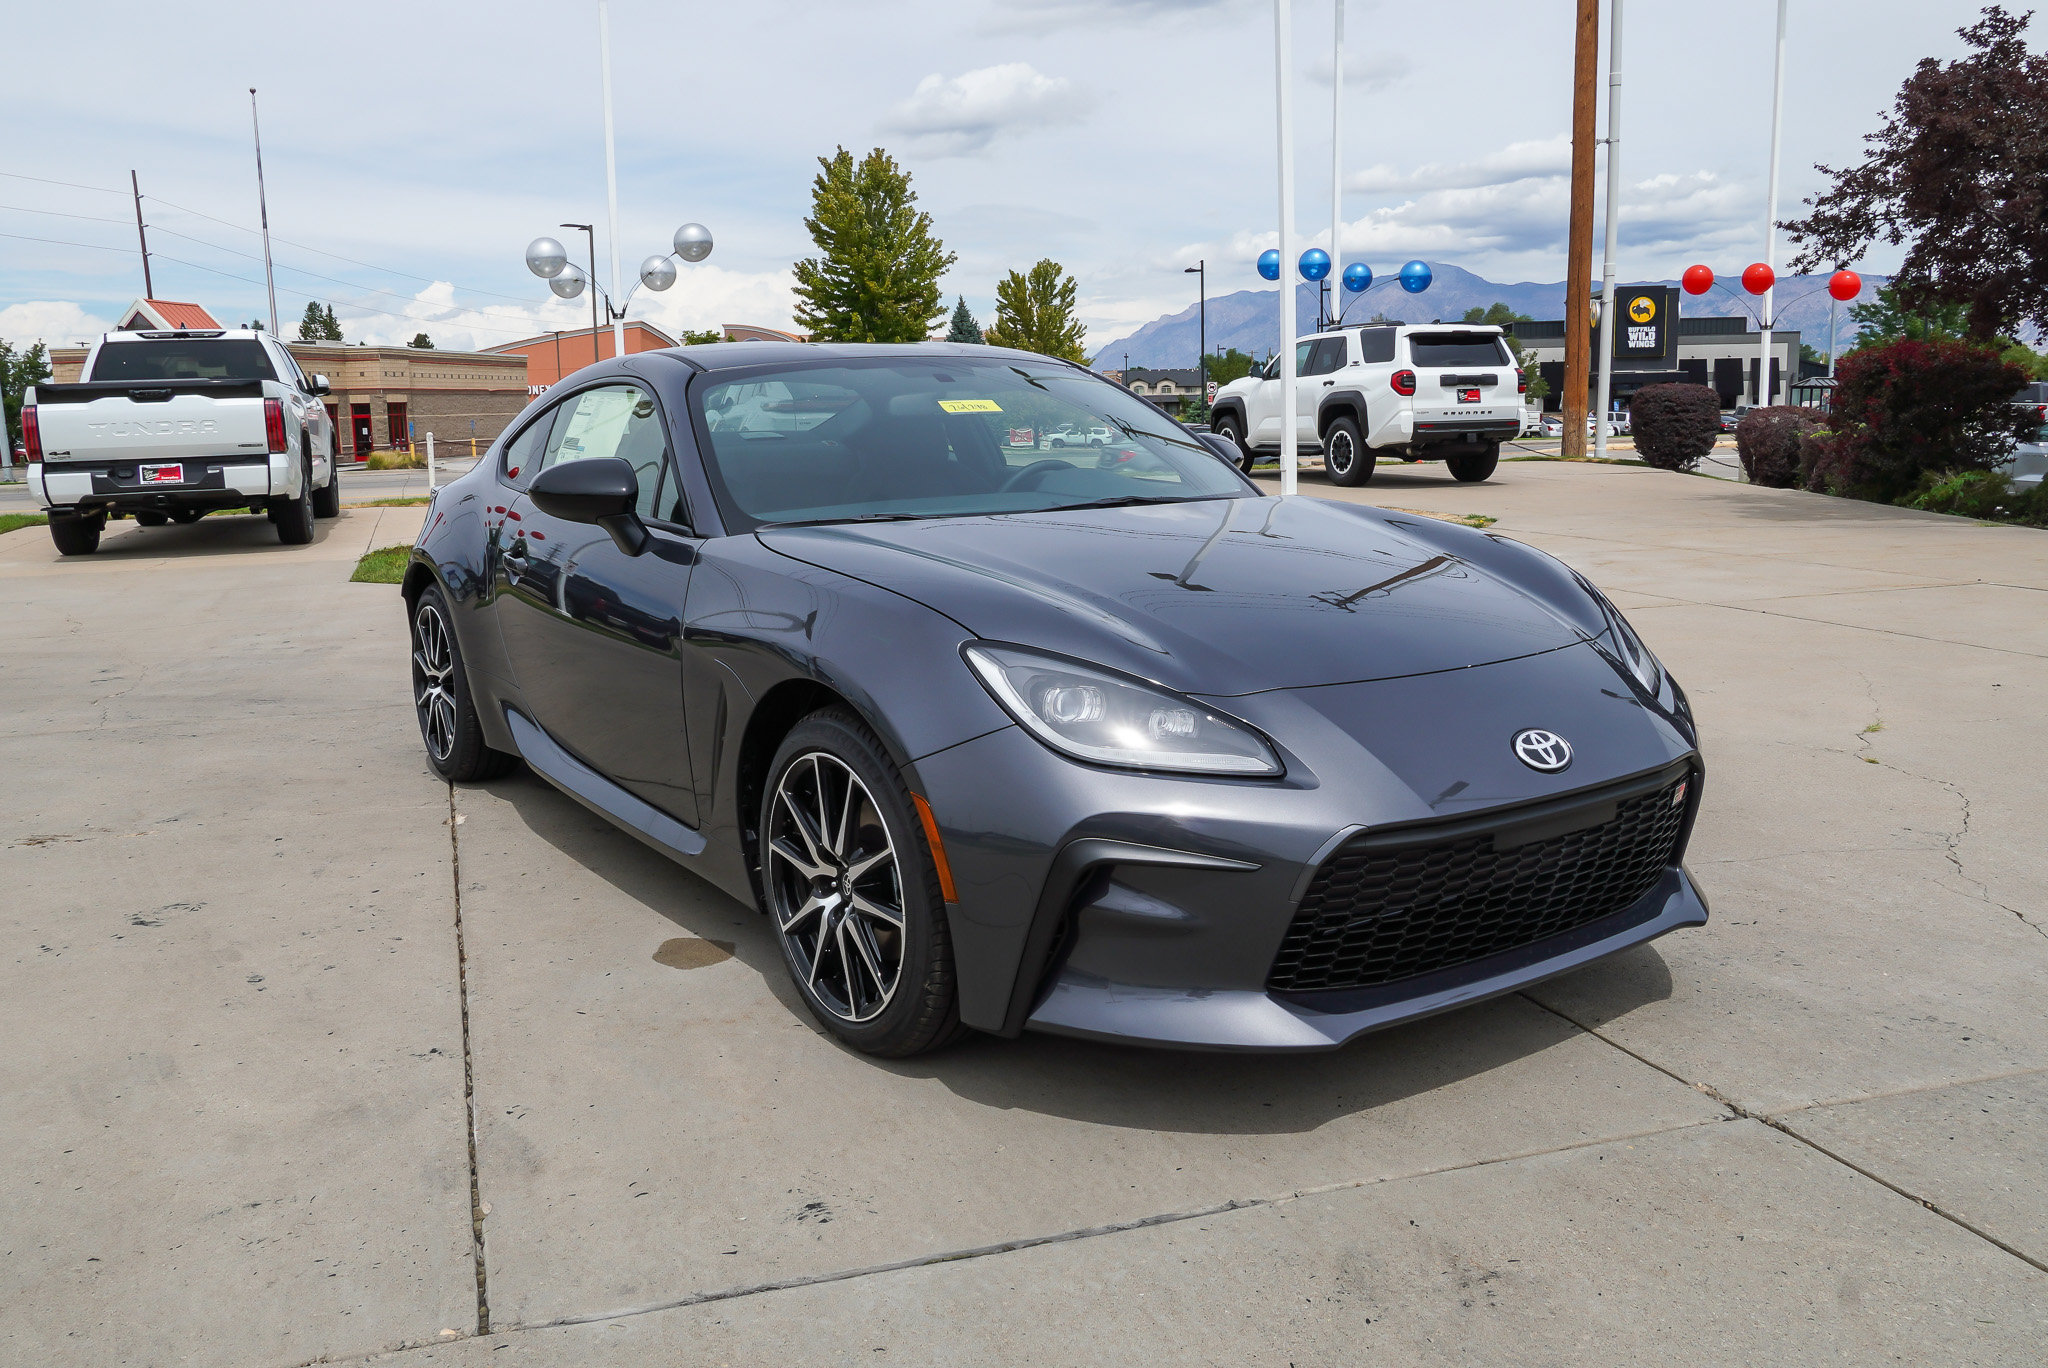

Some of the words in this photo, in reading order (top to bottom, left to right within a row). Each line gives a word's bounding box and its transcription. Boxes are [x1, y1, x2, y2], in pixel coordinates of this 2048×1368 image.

[1628, 332, 1656, 341] WILD
[1628, 340, 1656, 348] WINGS
[88, 419, 218, 438] TUNDRA
